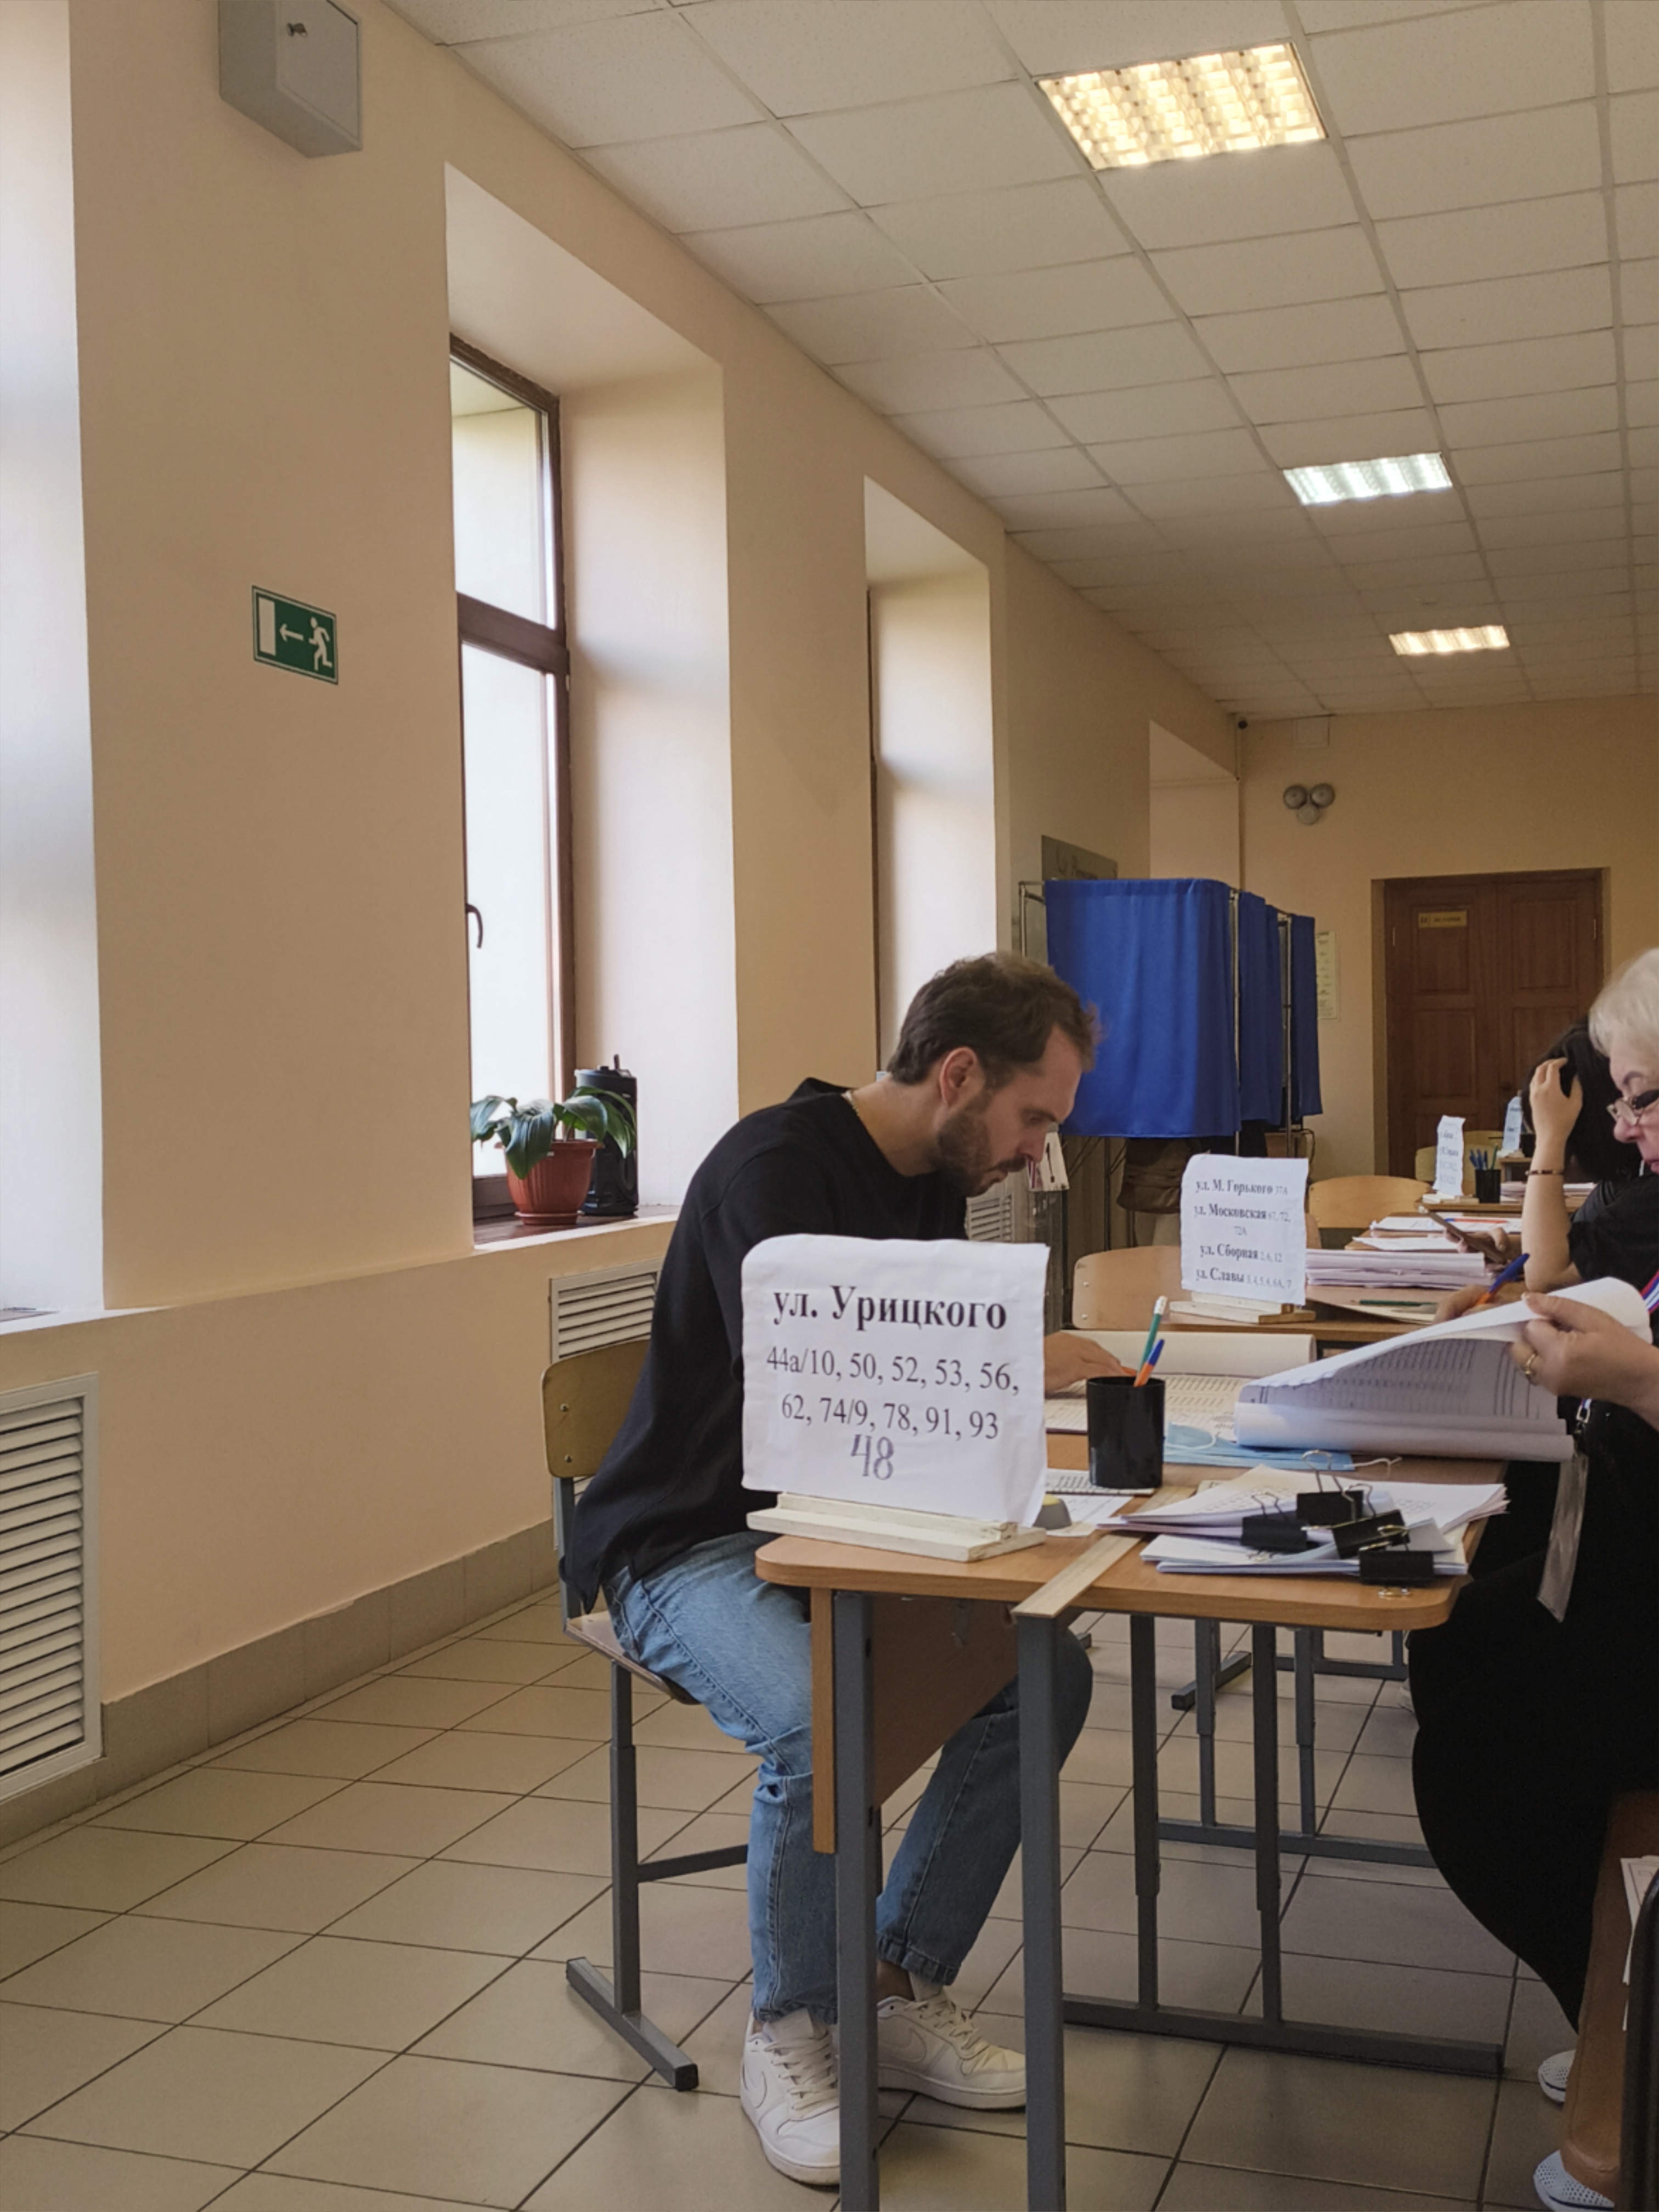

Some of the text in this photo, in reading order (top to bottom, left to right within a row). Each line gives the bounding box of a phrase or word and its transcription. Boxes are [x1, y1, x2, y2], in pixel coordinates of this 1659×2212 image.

[1212, 1179, 1224, 1192] М.
[1227, 1179, 1273, 1196] Горького
[1208, 1203, 1267, 1219] Московская
[1217, 1243, 1258, 1261] Сборная
[1210, 1267, 1245, 1283] Славы
[773, 1285, 1007, 1331] ул. Урицкого
[766, 1347, 1019, 1395] 44а/10, 50, 52, 53, 56,
[781, 1393, 998, 1441] 62, 74/9, 78, 91, 93
[850, 1433, 894, 1480] 48
